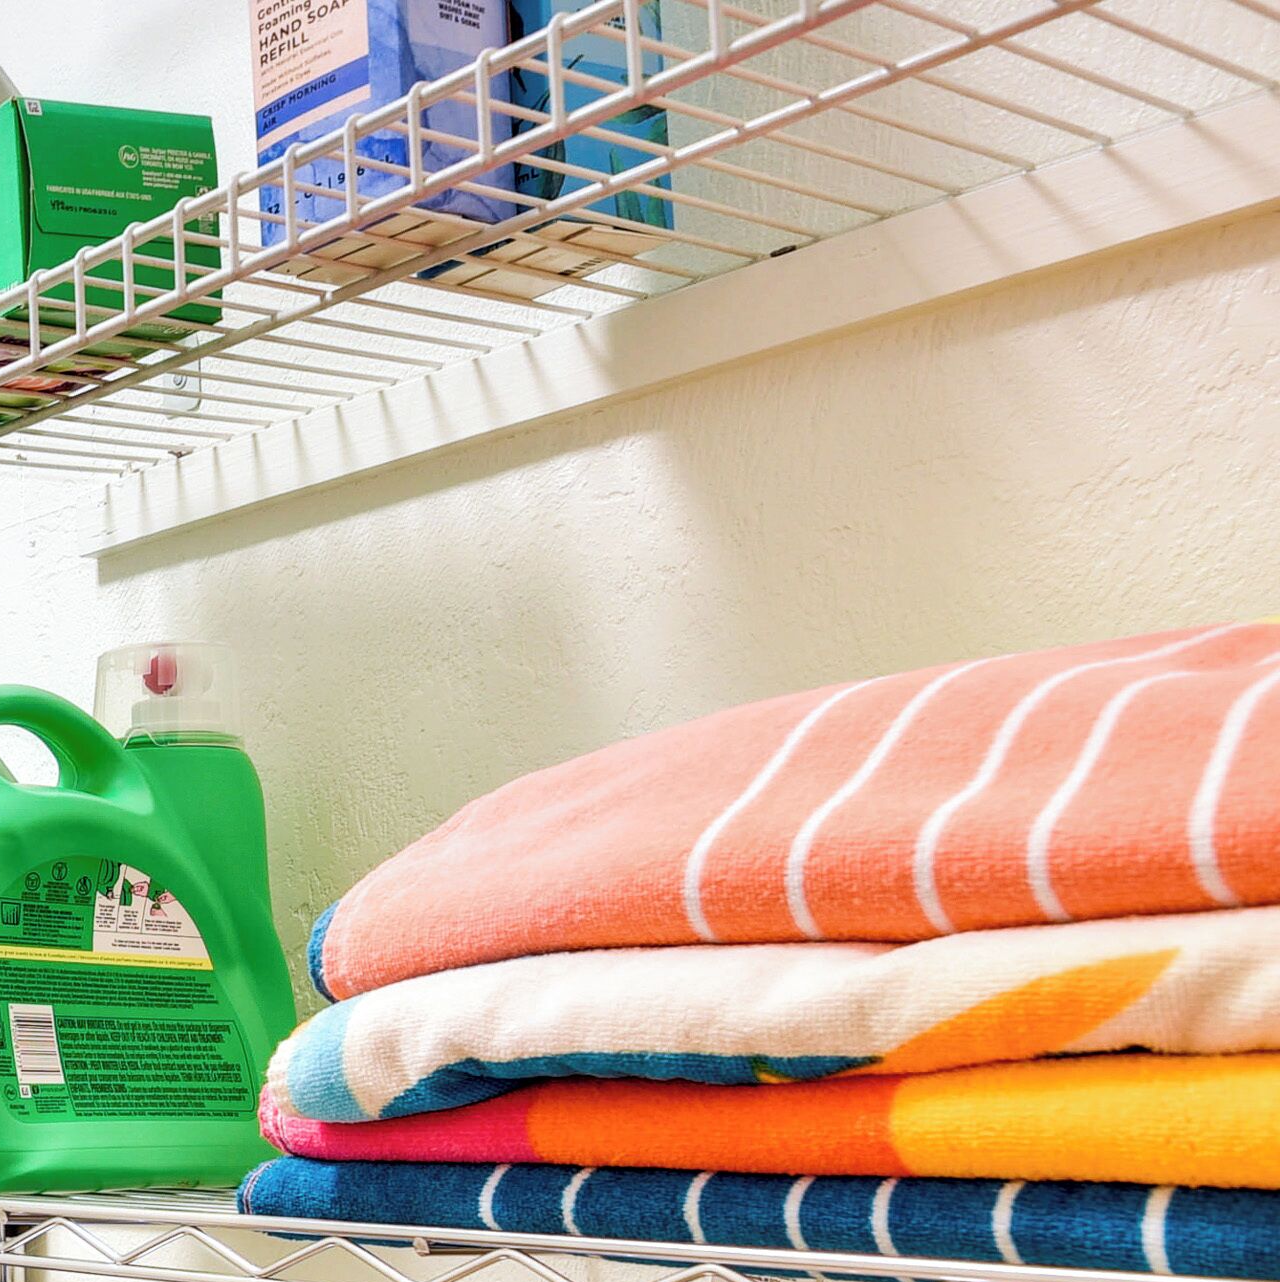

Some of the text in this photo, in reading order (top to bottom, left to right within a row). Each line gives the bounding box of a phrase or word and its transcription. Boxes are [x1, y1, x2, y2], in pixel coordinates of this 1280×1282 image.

[258, 1, 312, 35] Foaming
[259, 18, 302, 52] HAND
[260, 32, 309, 68] REFILL
[262, 74, 337, 119] CRISP MORNING
[262, 117, 277, 132] AIR
